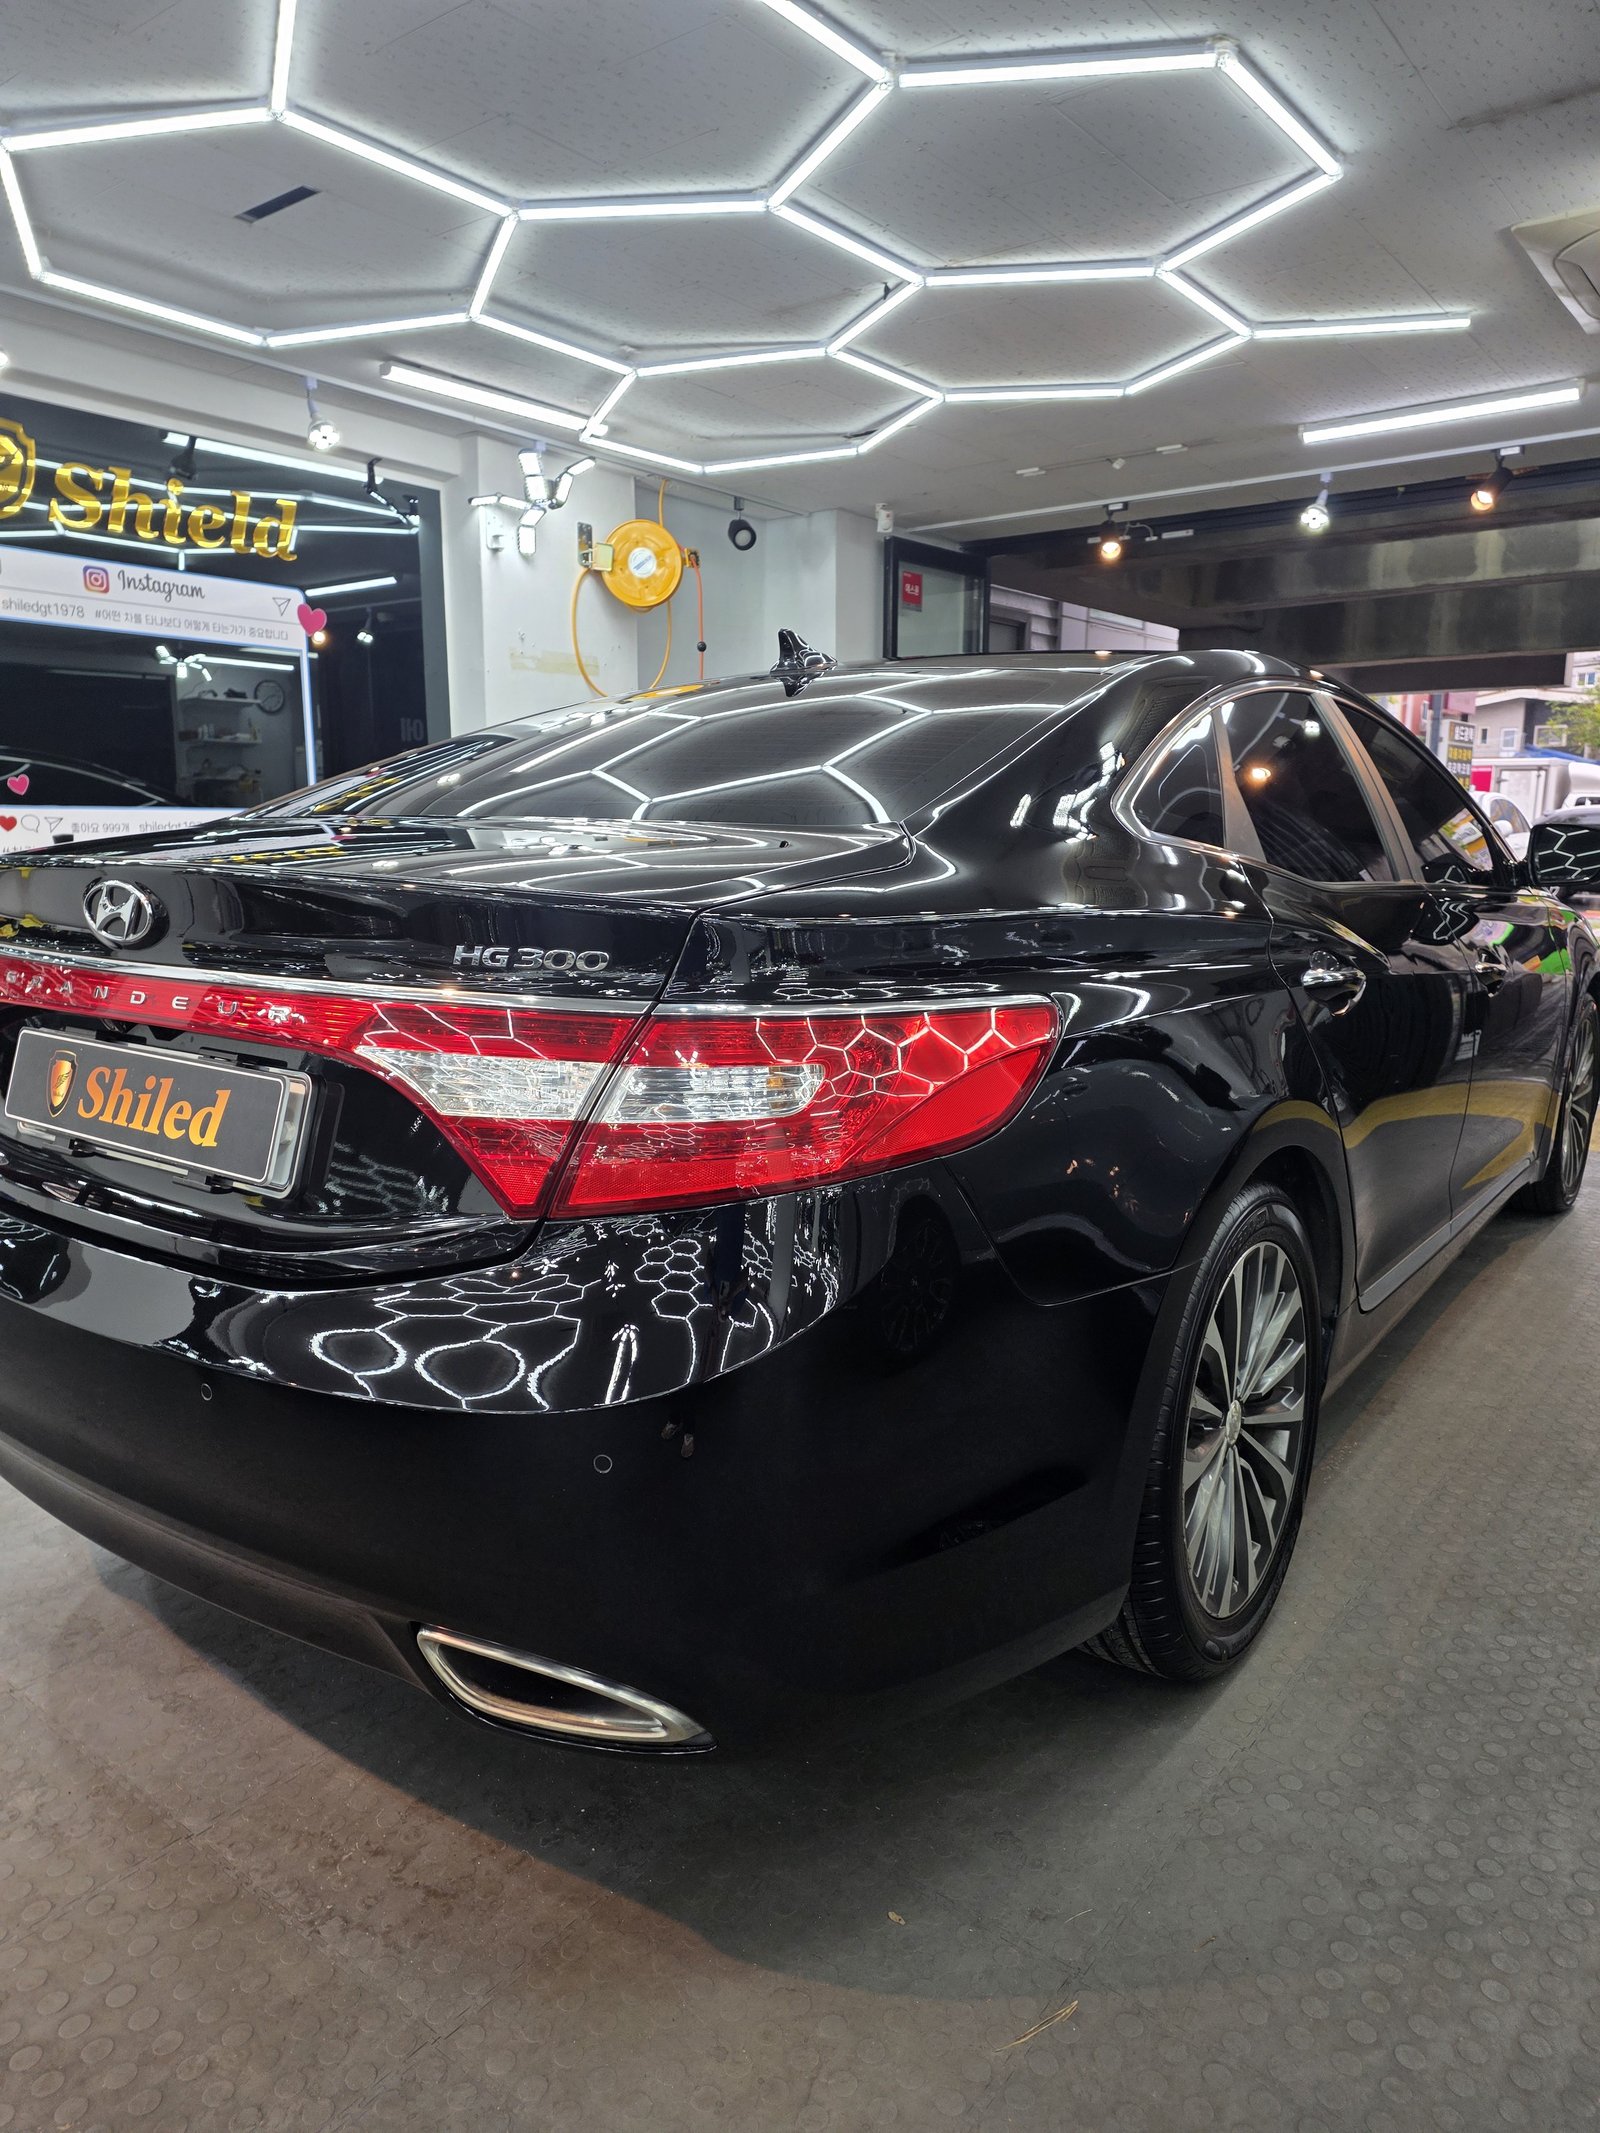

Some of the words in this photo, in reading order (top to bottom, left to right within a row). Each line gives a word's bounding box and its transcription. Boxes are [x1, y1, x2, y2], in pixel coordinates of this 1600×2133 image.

[49, 462, 297, 561] Shield
[117, 569, 205, 603] Instagram
[2, 597, 85, 618] shiledgt1978
[452, 945, 510, 968] HG
[513, 947, 610, 972] 300
[77, 1066, 231, 1147] Shiled
